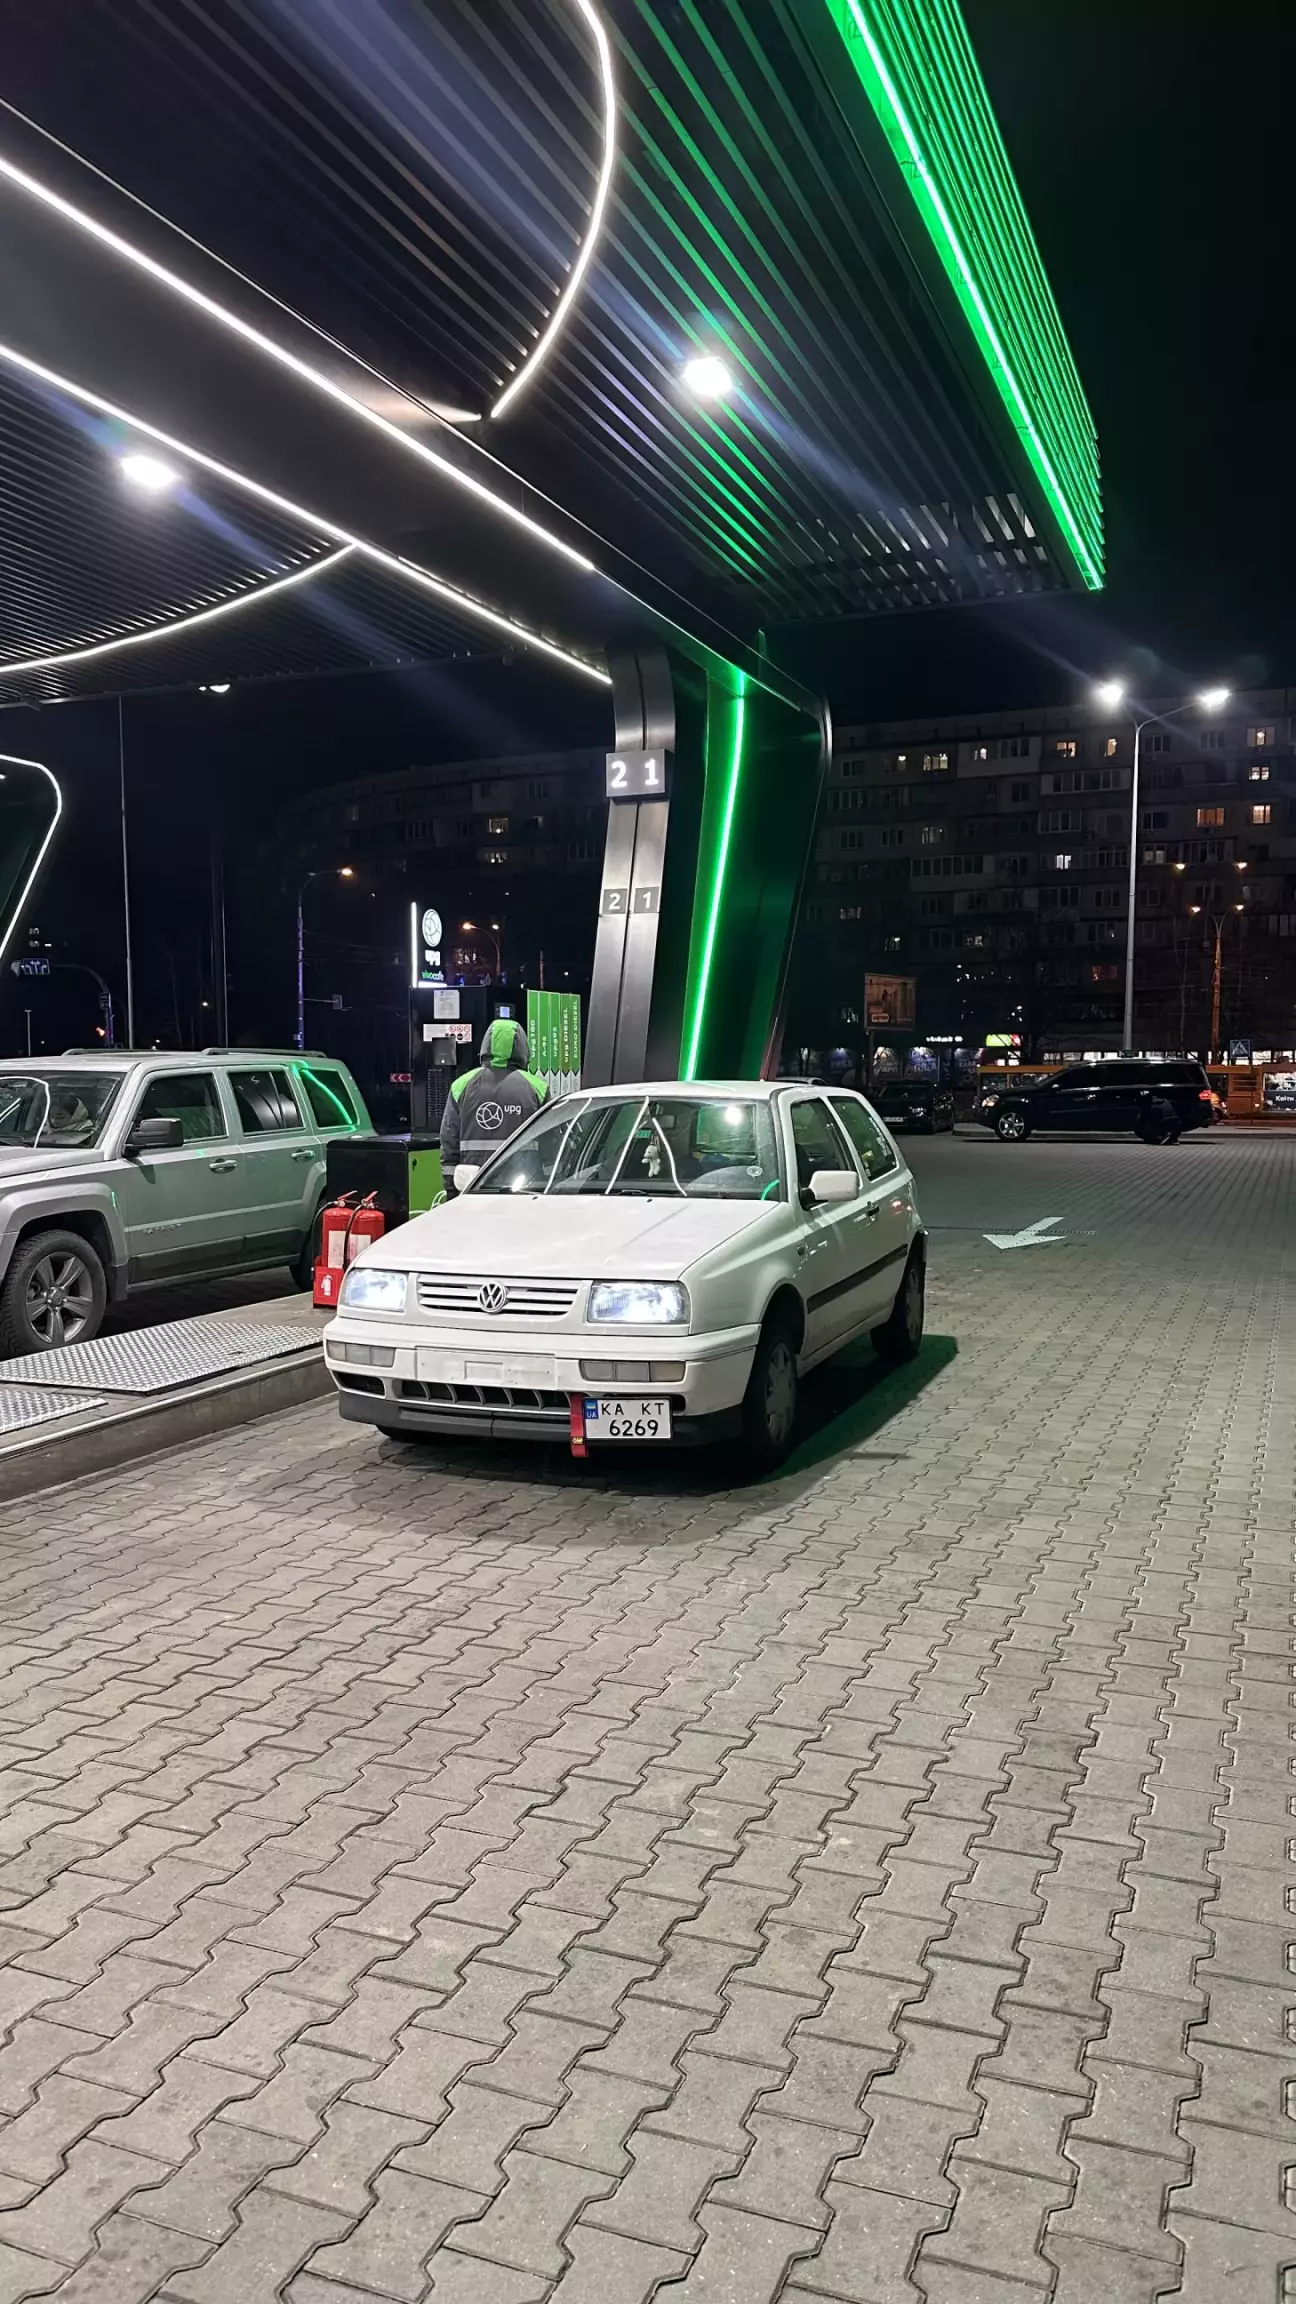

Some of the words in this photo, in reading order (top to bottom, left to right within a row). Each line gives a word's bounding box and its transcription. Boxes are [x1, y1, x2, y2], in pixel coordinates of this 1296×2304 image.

[611, 760, 628, 788] 2
[644, 758, 659, 786] 1
[608, 892, 621, 910] 2
[642, 891, 652, 909] 1
[504, 1105, 521, 1115] upg
[587, 1411, 597, 1419] UA
[601, 1402, 624, 1416] KA
[641, 1402, 665, 1415] KT
[609, 1419, 659, 1437] 6269
